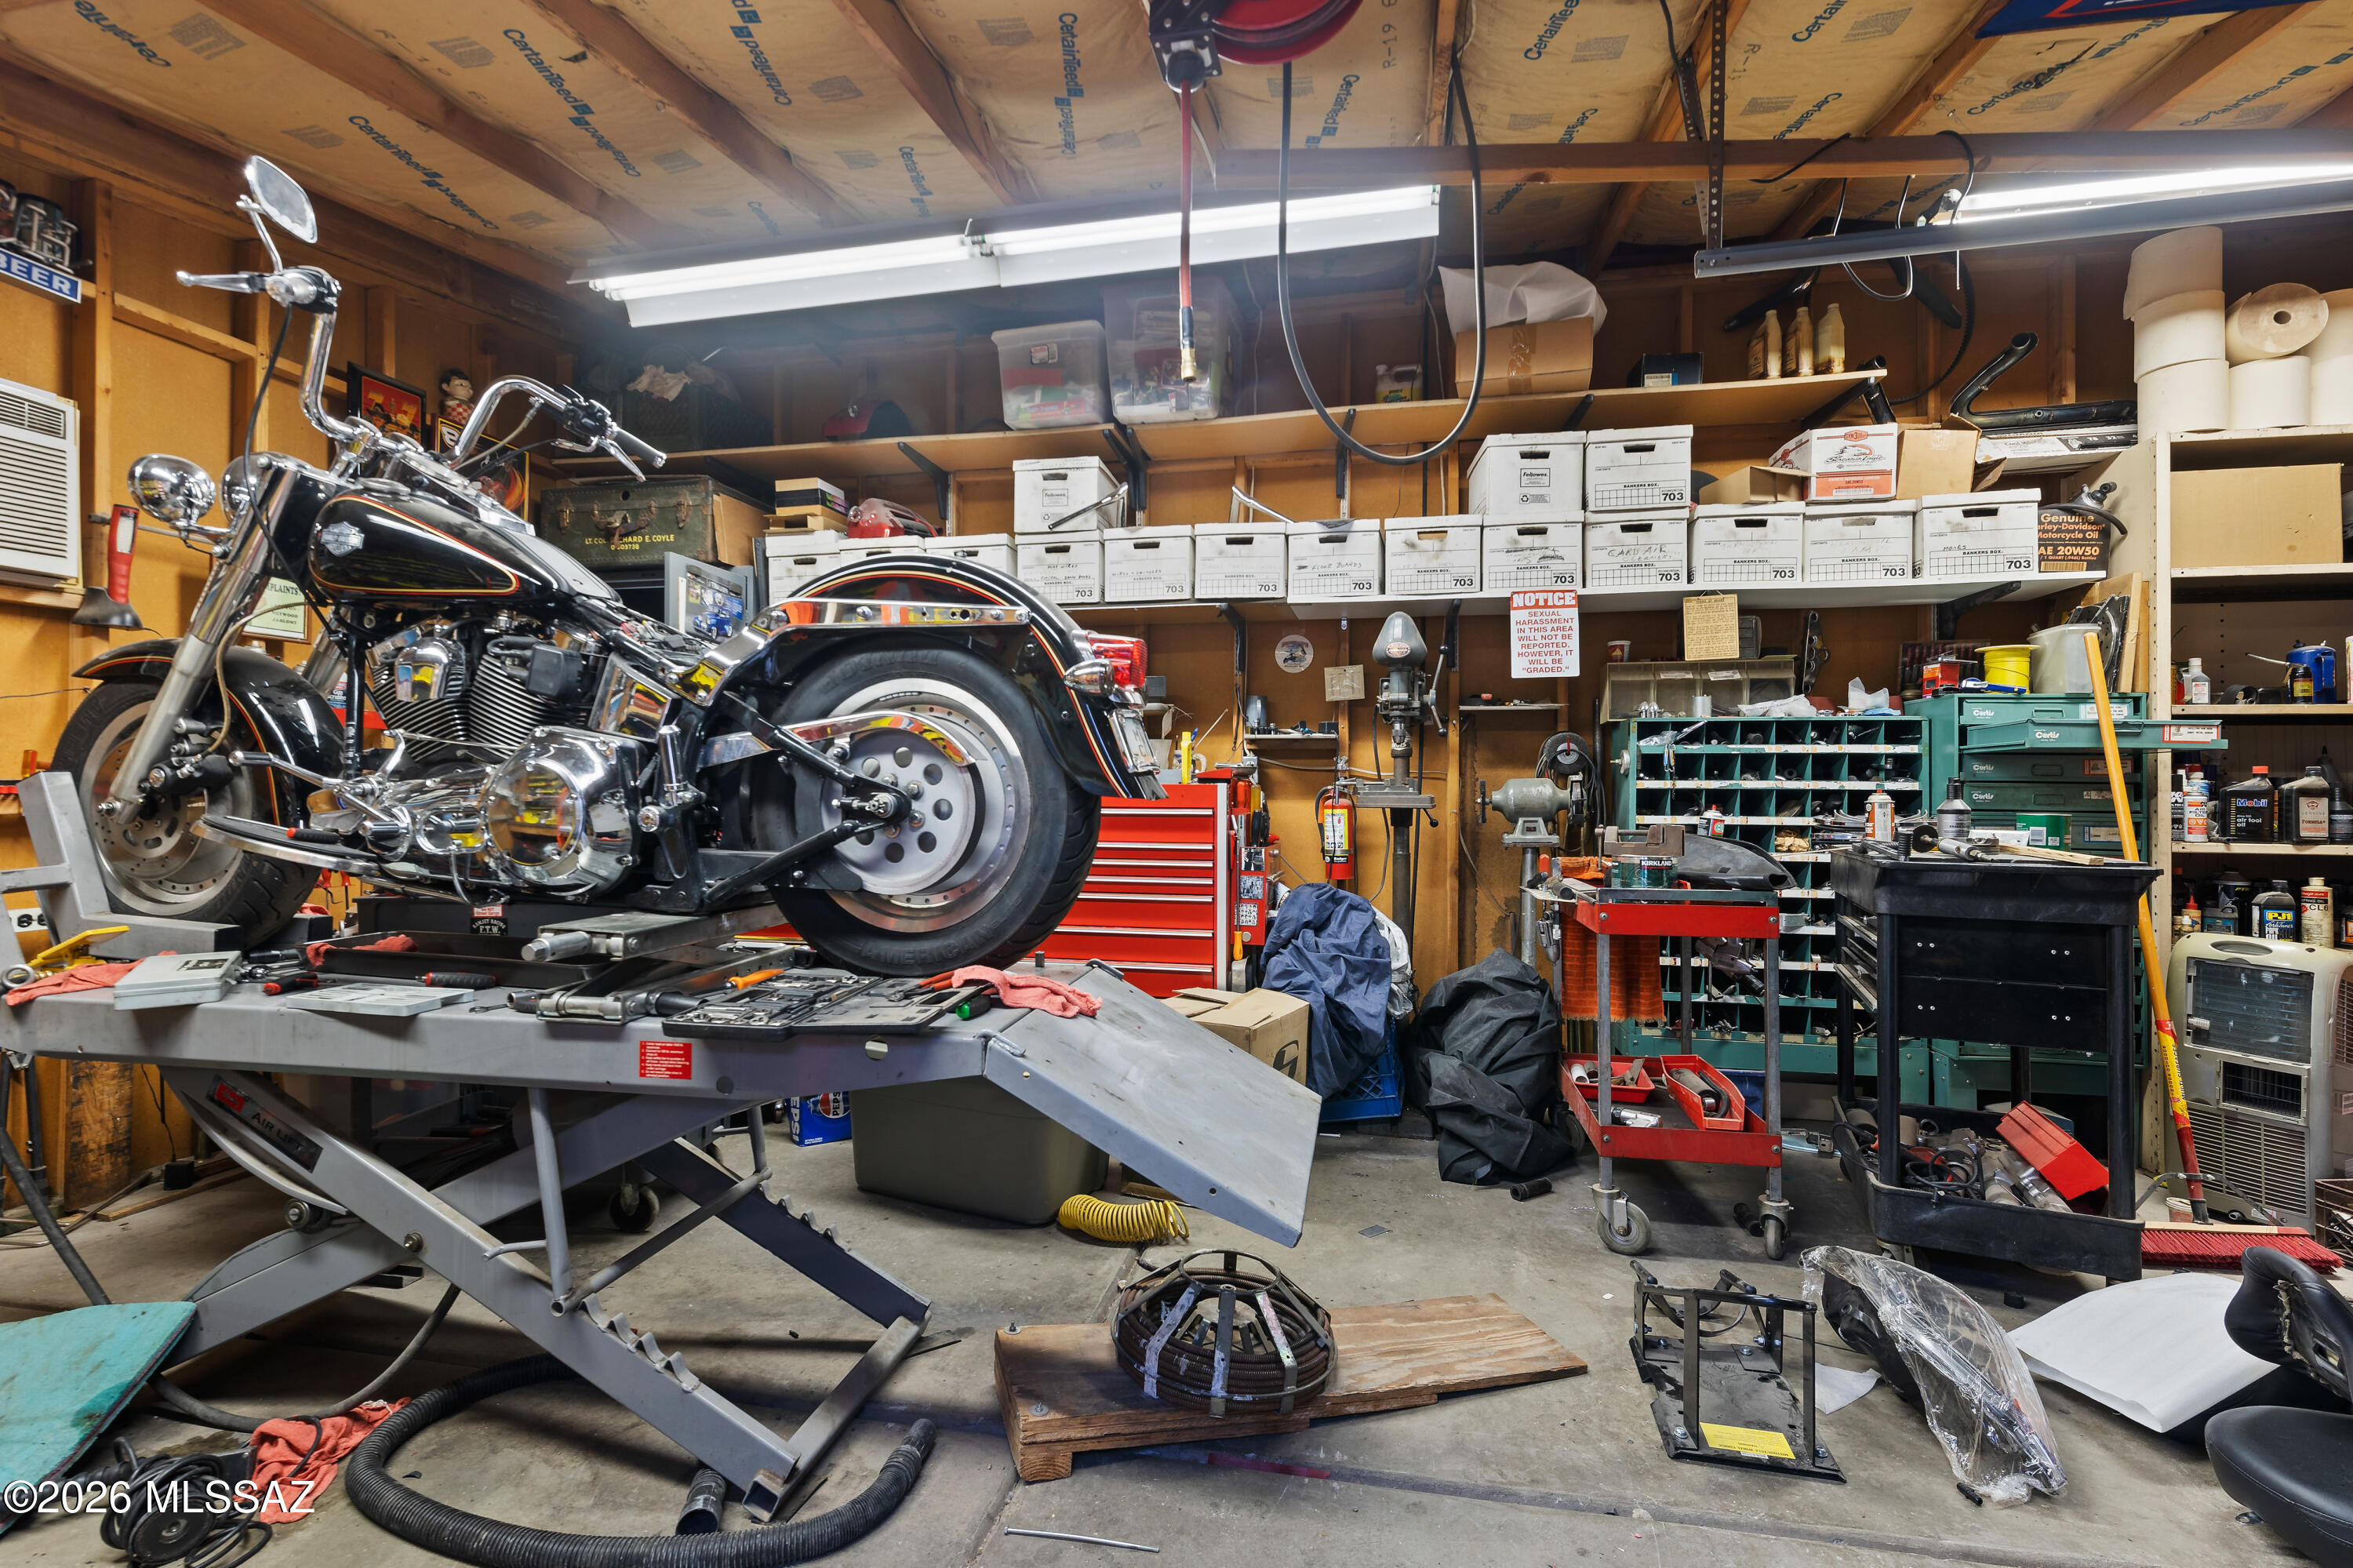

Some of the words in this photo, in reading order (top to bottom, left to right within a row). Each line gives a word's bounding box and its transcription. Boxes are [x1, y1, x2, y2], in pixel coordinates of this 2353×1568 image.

[1059, 13, 1085, 88] CertainTeed
[1382, 23, 1398, 69] R-19
[503, 28, 580, 105] CertainTeed
[739, 41, 793, 106] CertainTeed
[348, 115, 433, 173] CertainTeed
[1661, 492, 1684, 501] 703
[2041, 513, 2094, 522] Genuine
[2038, 546, 2053, 555] AE
[2057, 546, 2100, 555] 20W50
[2006, 560, 2031, 569] 703
[1657, 573, 1680, 581] 703
[1882, 568, 1906, 577] 703
[1352, 582, 1373, 591] 703
[1453, 578, 1474, 587] 703
[267, 582, 301, 596] PLAINTS
[1075, 589, 1093, 598] 703
[1512, 591, 1576, 607] NOTICE
[2035, 730, 2060, 740] Curtis
[1973, 763, 1995, 772] Curtis
[1972, 791, 1994, 800] Curtis
[2237, 799, 2268, 807] Mobil
[832, 1091, 841, 1116] PEPS
[252, 1112, 275, 1132] AIR
[791, 1096, 800, 1141] EPSI
